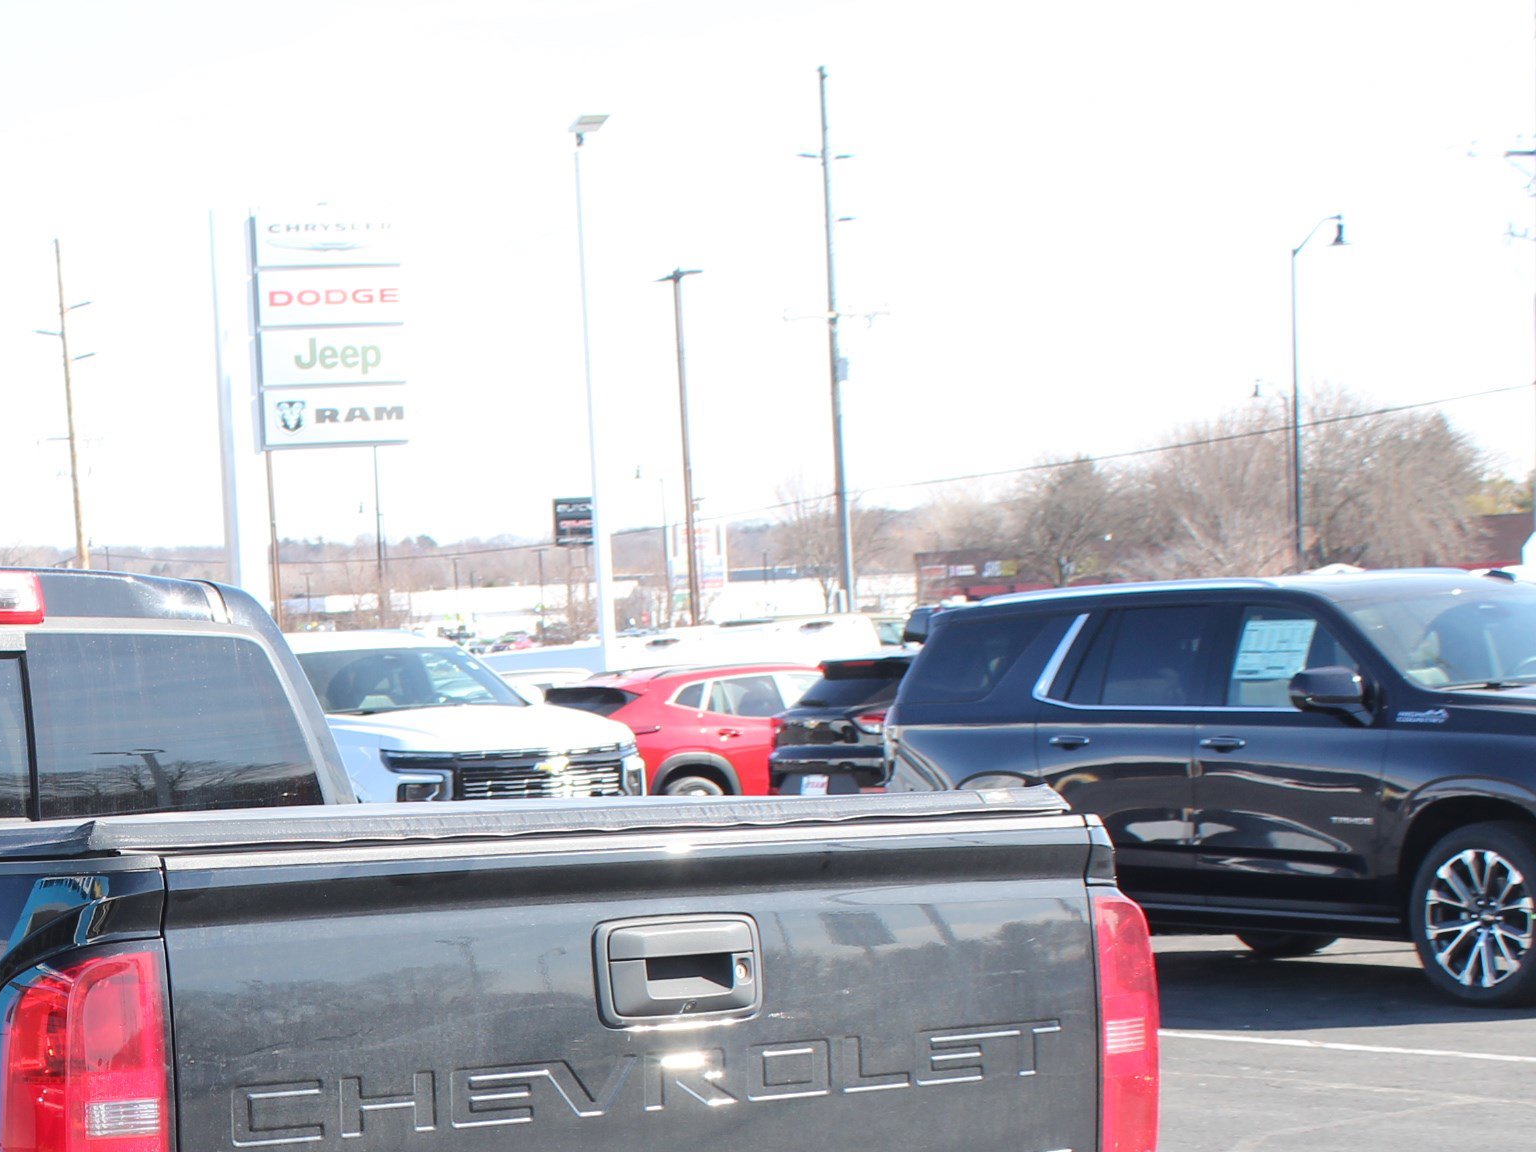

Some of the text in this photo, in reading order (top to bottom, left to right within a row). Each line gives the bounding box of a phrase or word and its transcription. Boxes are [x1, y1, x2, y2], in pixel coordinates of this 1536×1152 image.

[267, 222, 392, 234] CHRYSLER
[268, 288, 400, 307] DODGE
[294, 337, 382, 375] Jeep
[315, 405, 405, 424] RAM
[231, 1018, 1062, 1147] CHEVROLET
